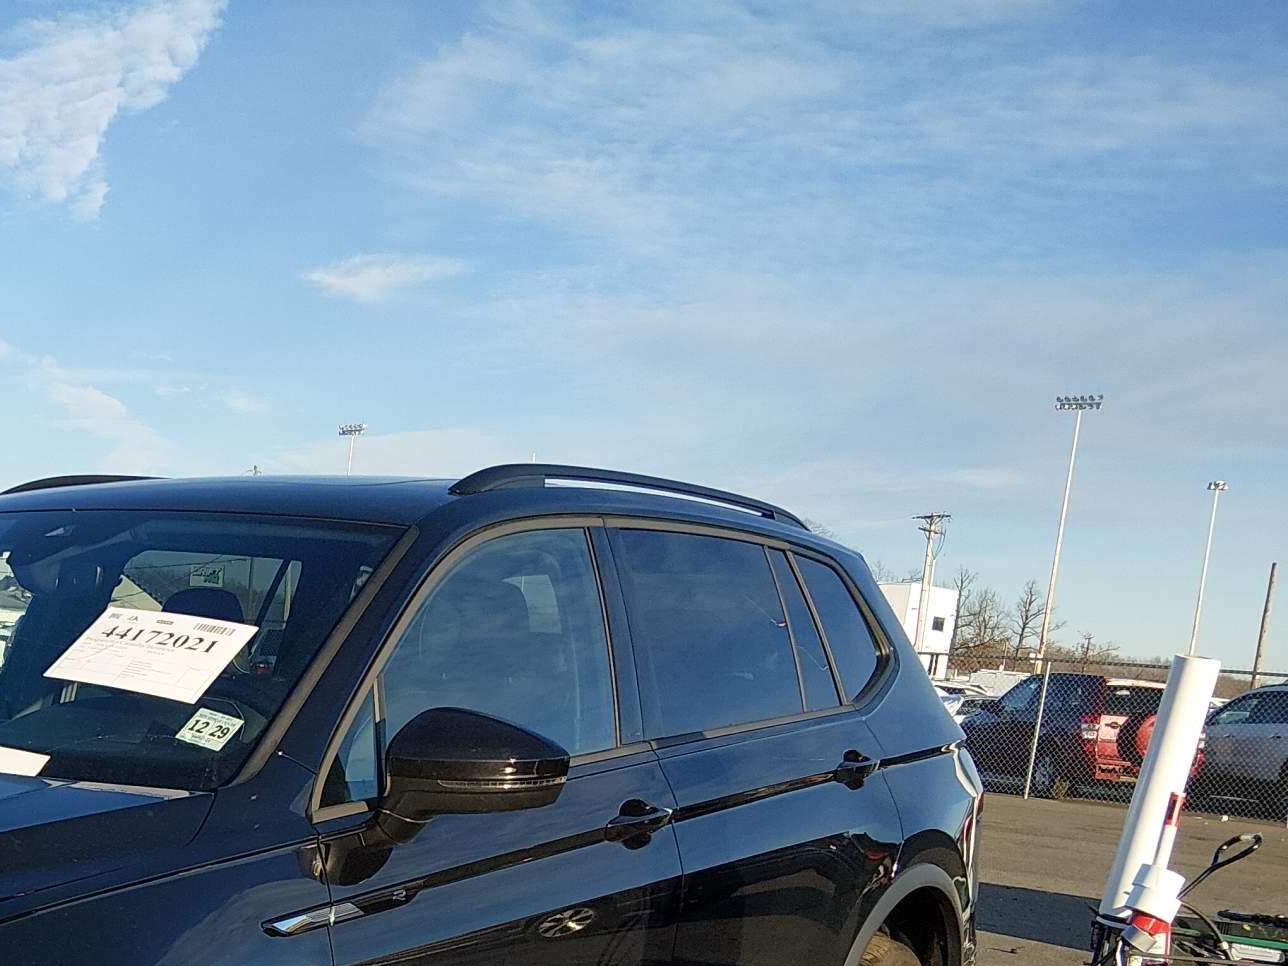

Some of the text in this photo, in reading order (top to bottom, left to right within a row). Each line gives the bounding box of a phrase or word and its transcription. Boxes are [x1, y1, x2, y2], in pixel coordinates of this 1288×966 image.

[101, 625, 219, 654] 44172021
[188, 719, 210, 734] 12
[208, 725, 230, 739] 29
